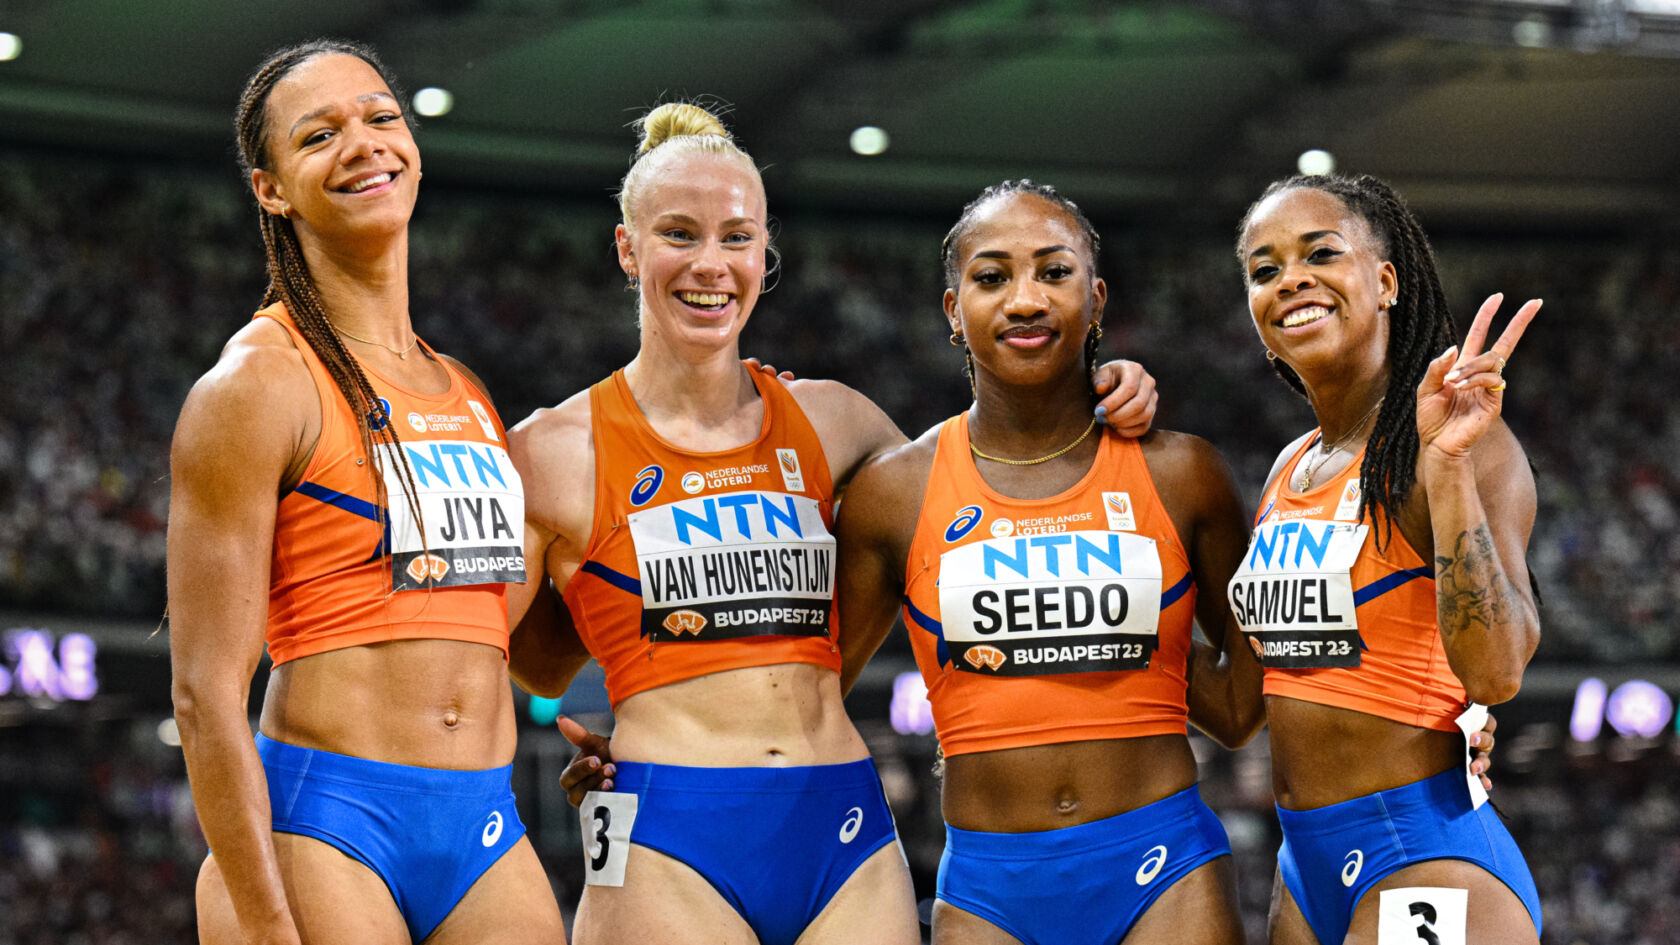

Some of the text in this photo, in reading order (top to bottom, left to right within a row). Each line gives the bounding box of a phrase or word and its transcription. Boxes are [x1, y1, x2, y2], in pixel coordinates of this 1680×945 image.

[405, 444, 507, 489] NTN
[705, 464, 769, 479] NEDERLANDSE
[707, 475, 752, 488] LOTERIJ
[440, 498, 514, 541] JIYA
[671, 493, 804, 545] NTN
[1016, 512, 1093, 527] NEDERLANDSE
[1016, 524, 1067, 537] LOTERIJ
[982, 533, 1122, 580] NTN
[1250, 522, 1335, 571] NTN
[645, 548, 830, 602] VAN HUNENSTIJN
[972, 583, 1129, 635] SEEDO
[1232, 579, 1343, 627] SAMUEL
[1263, 640, 1350, 657] UDAPEST 23
[592, 805, 612, 871] 3
[1408, 901, 1441, 945] 3
